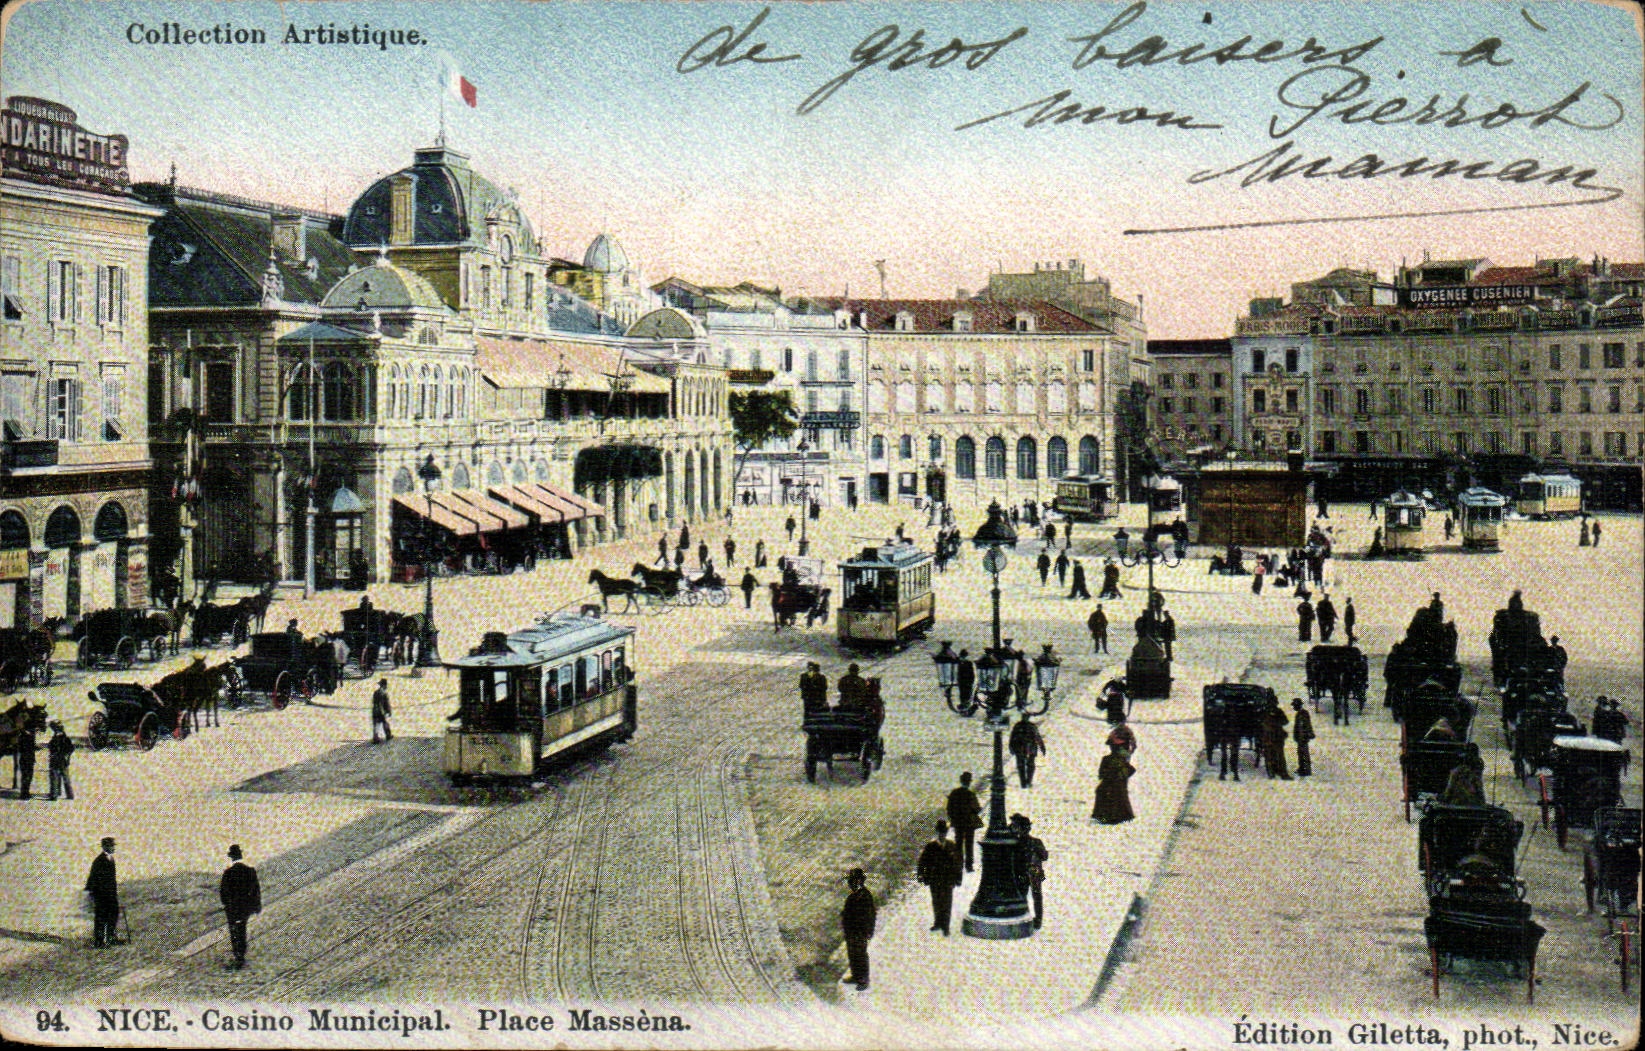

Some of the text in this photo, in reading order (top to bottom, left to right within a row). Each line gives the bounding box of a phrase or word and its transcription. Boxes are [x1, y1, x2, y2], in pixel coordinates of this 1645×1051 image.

[677, 1, 1548, 116] de gros baisers à
[14, 100, 47, 119] LIQUEUR
[955, 66, 1625, 138] mon Pierrot
[27, 153, 50, 168] TOUS
[1473, 286, 1531, 300] CUSENIER
